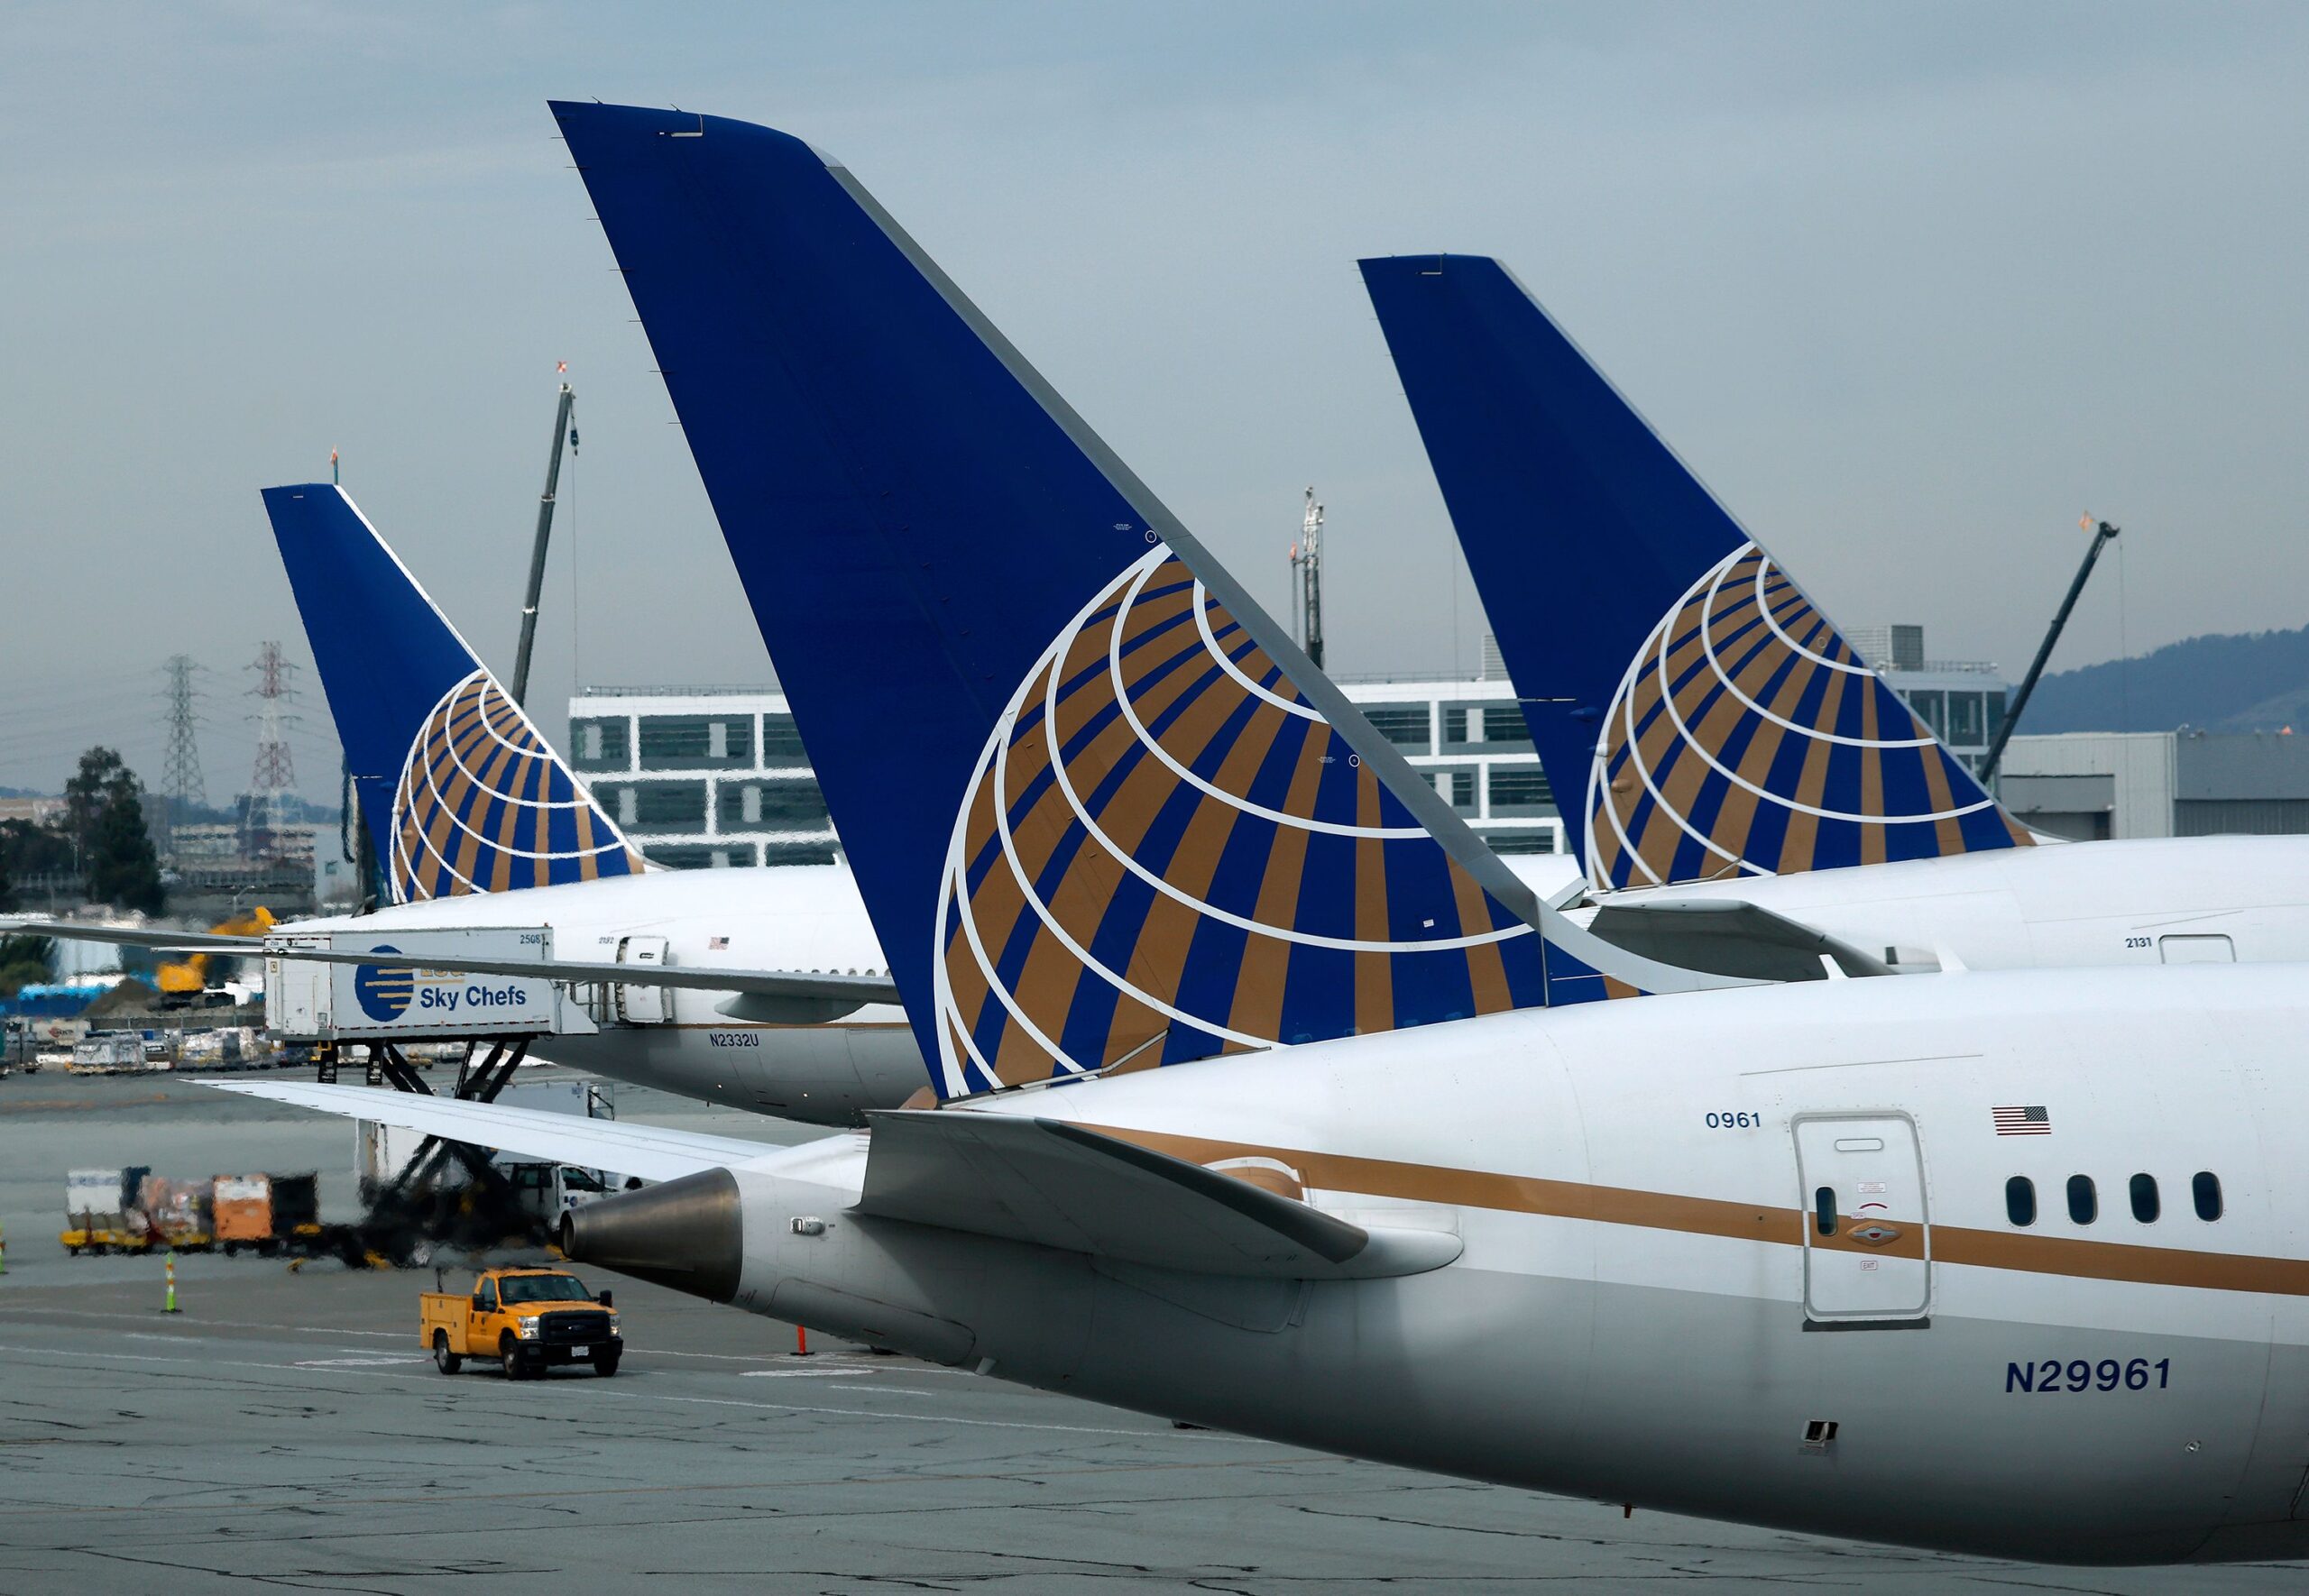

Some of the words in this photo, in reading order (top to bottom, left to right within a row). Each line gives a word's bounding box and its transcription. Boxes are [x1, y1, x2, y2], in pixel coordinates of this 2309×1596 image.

[2125, 937, 2152, 948] 2131
[420, 987, 459, 1011] Sky
[465, 986, 527, 1007] Chefs
[709, 1033, 759, 1047] N2332U
[1706, 1112, 1761, 1129] 0961
[2005, 1358, 2169, 1393] N29961
